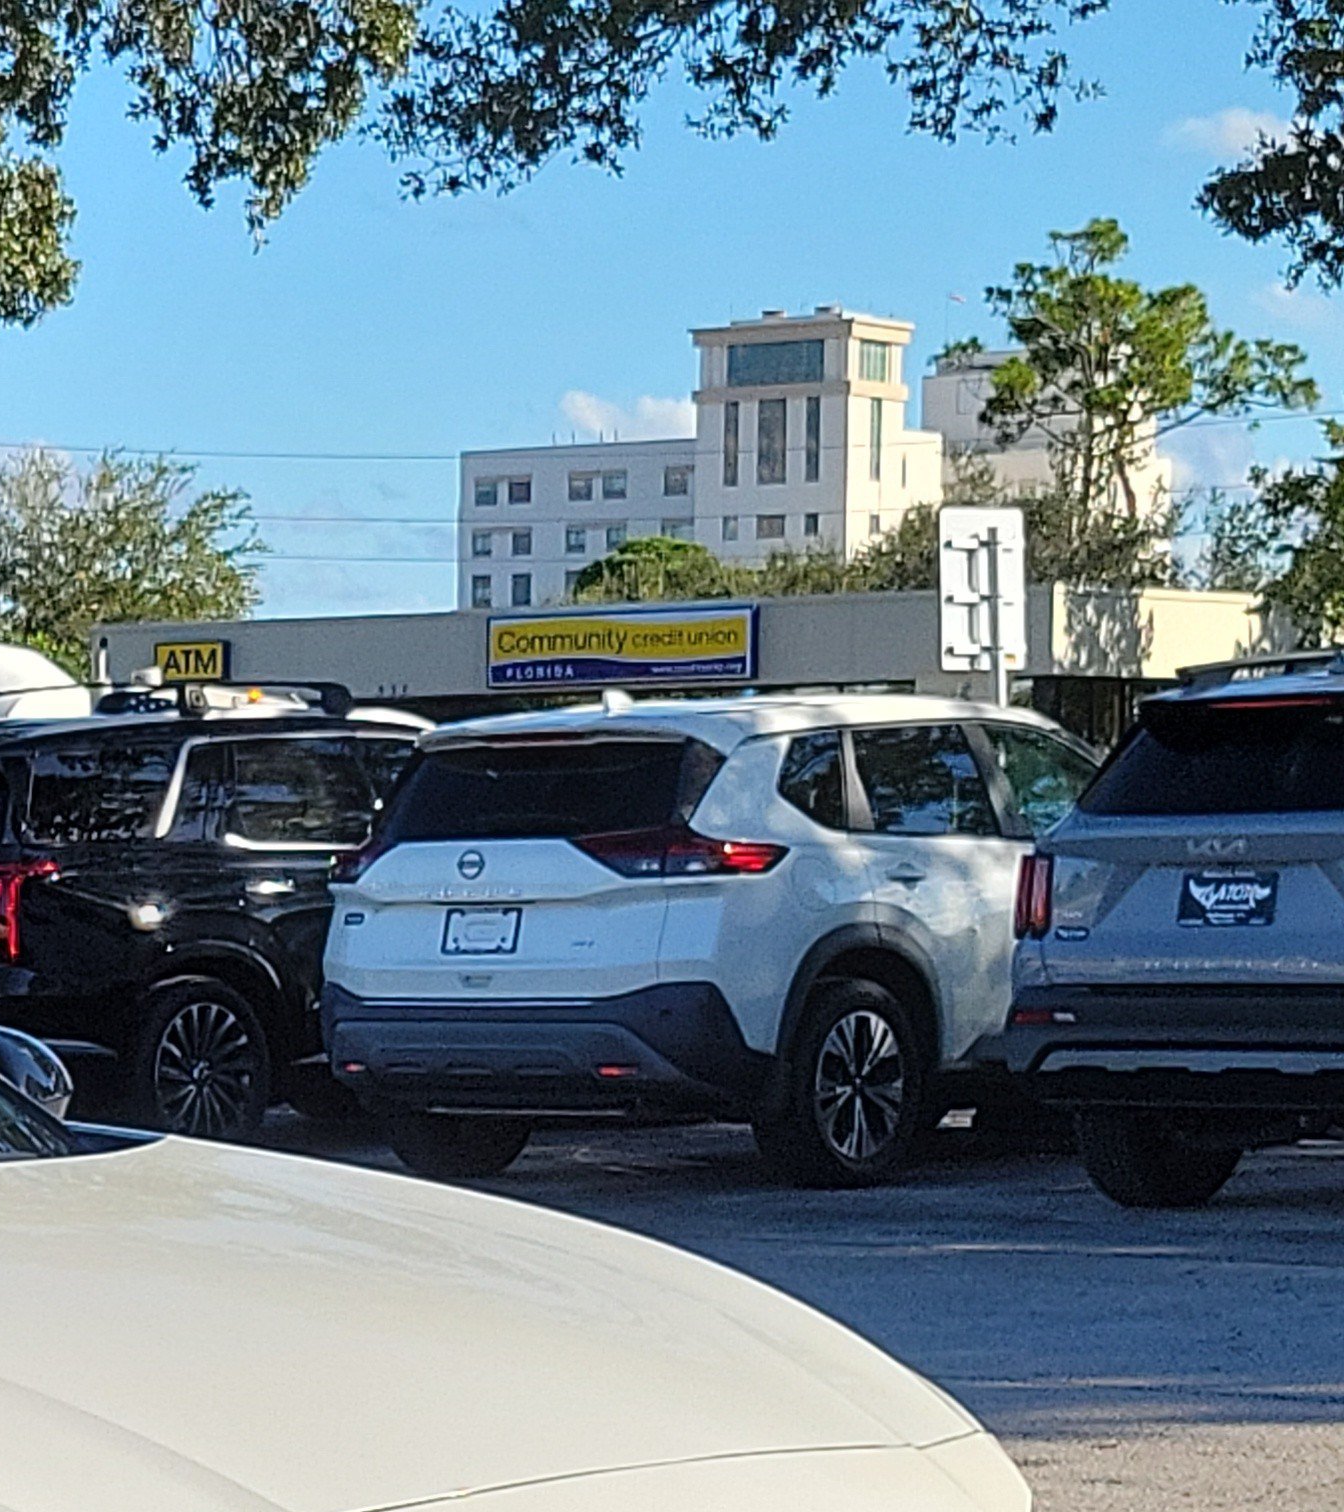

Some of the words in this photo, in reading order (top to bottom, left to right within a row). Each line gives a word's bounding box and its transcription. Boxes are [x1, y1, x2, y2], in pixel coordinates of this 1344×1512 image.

[498, 630, 627, 654] Community
[632, 630, 684, 649] credit
[687, 629, 738, 645] union
[163, 648, 217, 675] ATM
[506, 664, 574, 679] FLORIDA
